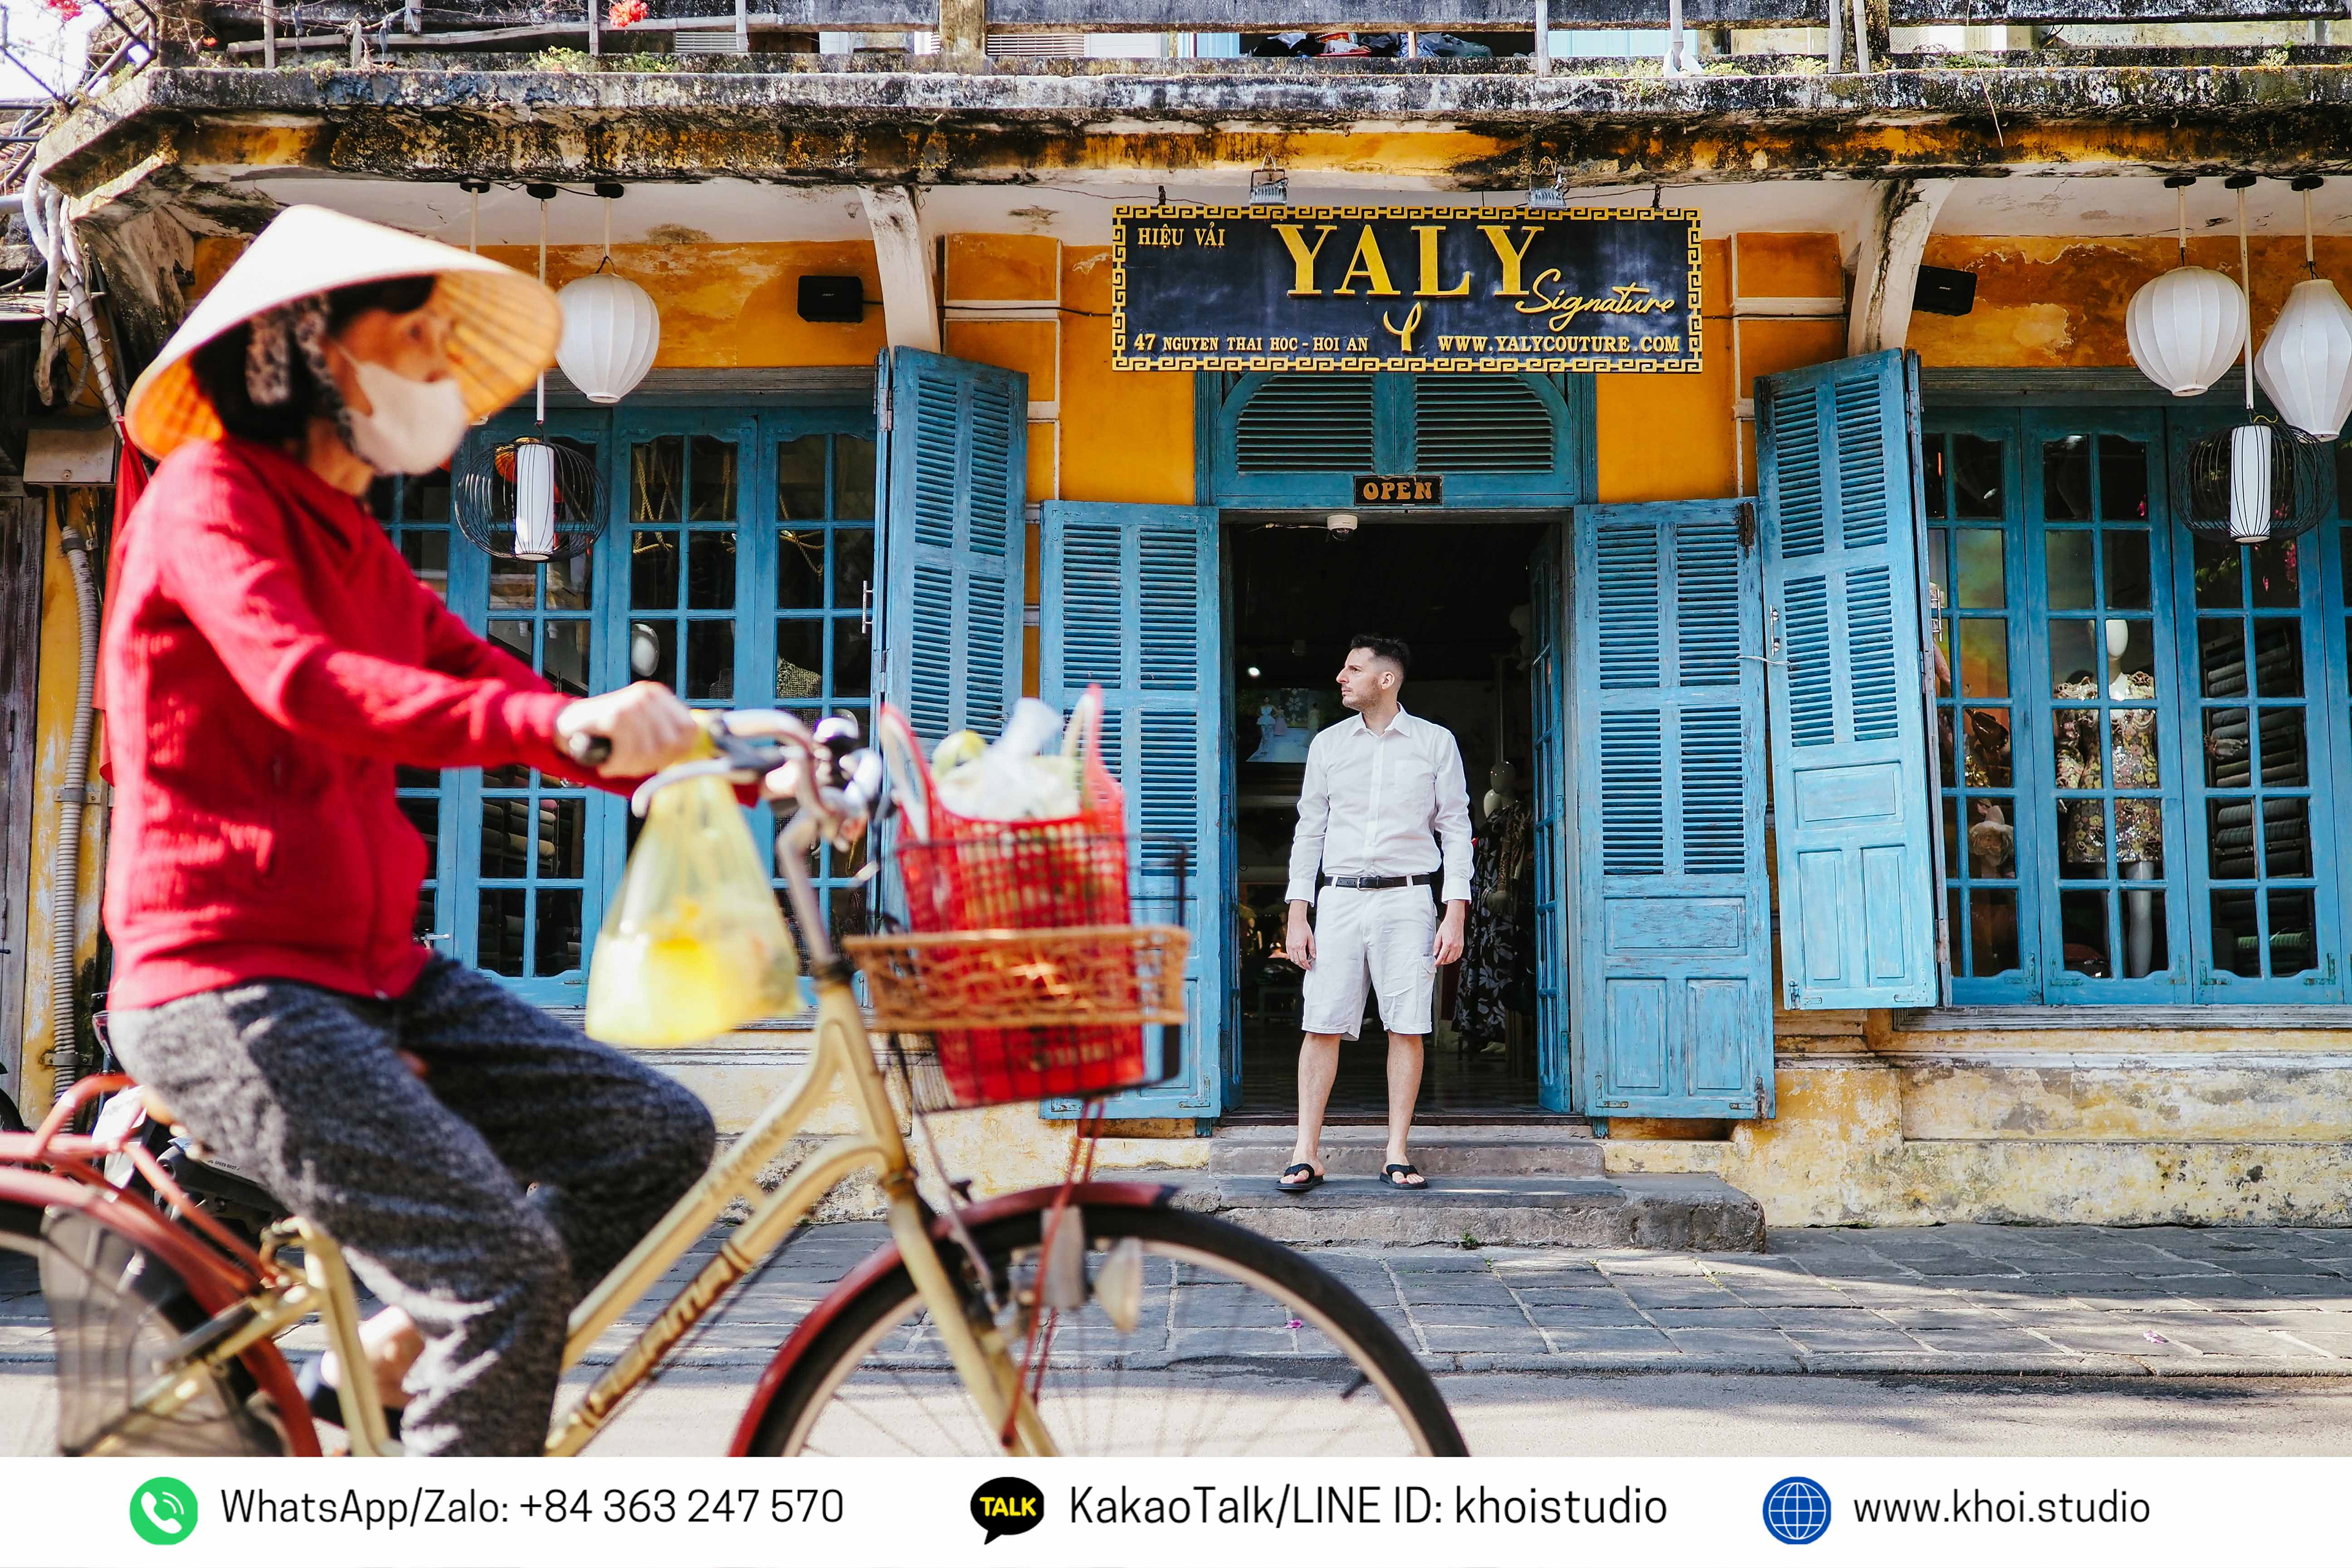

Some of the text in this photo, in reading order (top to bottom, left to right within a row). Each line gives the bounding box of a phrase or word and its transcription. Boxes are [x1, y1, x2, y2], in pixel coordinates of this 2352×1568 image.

[1194, 221, 1226, 246] VẢI
[1271, 224, 1545, 296] YALY
[1514, 268, 1675, 332] Signature
[1134, 333, 1156, 351] 47
[1163, 337, 1219, 352] NGUYEN
[1227, 337, 1263, 352] THAI
[1270, 337, 1298, 352] HOC
[1313, 337, 1340, 352] HOI
[1346, 337, 1368, 352] AN
[1437, 335, 1679, 353] WWW.YALYCOUTURE.COM
[1363, 481, 1433, 500] OPEN
